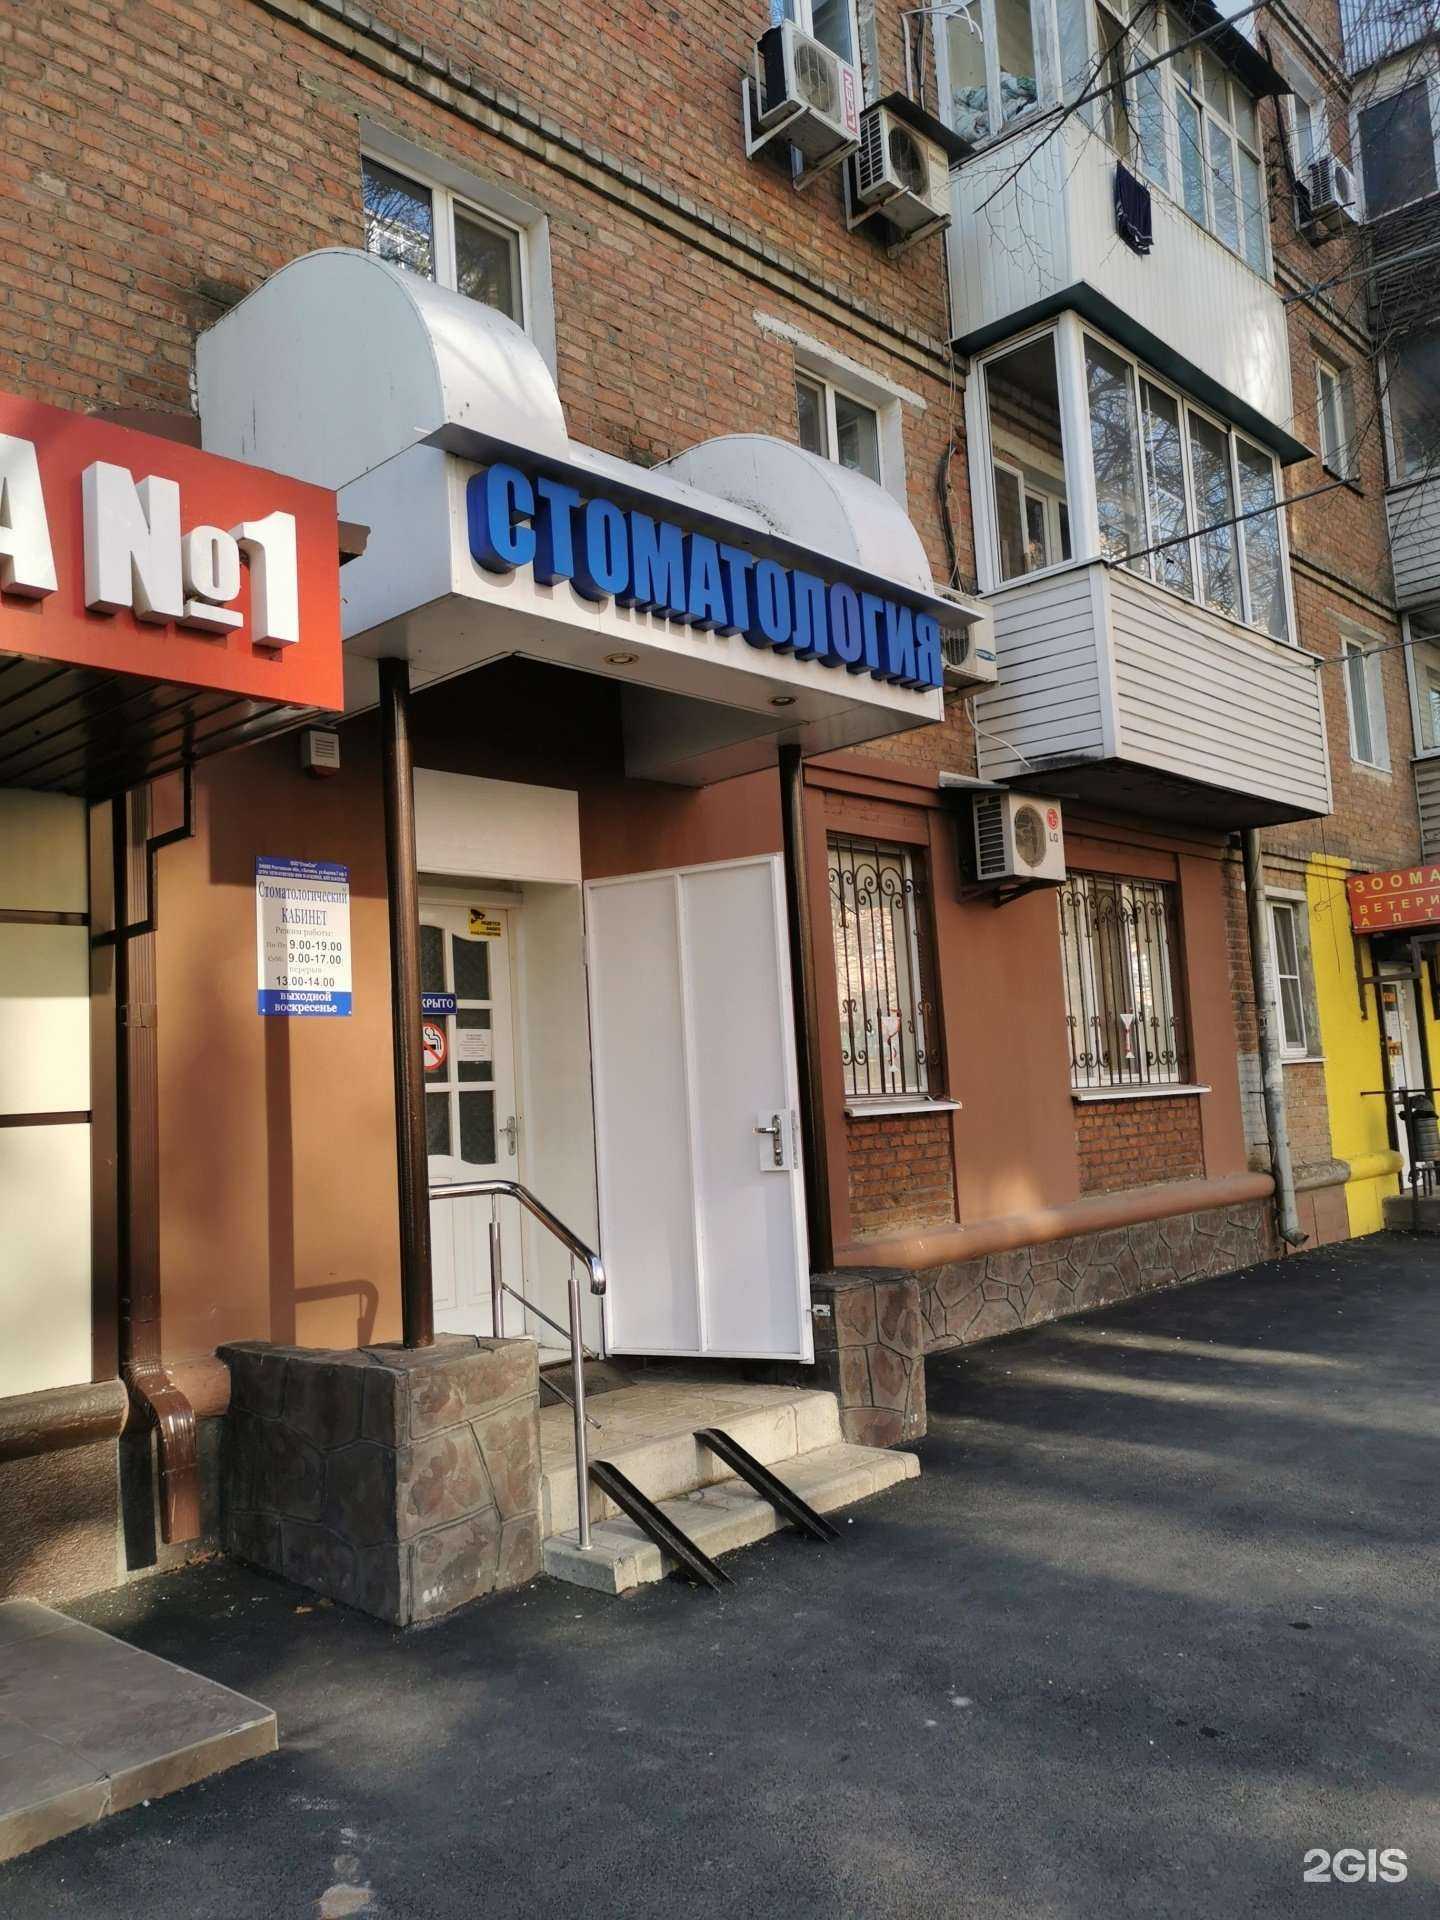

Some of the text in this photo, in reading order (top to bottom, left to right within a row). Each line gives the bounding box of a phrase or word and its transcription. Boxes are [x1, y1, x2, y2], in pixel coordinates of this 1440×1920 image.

[467, 463, 944, 692] СТОМАТОЛОГИЯ
[259, 881, 348, 904] Стоматологический
[281, 907, 327, 926] КАБИНЕТ
[289, 939, 342, 951] 9.00-19.00
[288, 952, 342, 965] 9.00-17.00
[275, 975, 335, 987] 13.00-14.00
[274, 1003, 338, 1014] воскресенье
[422, 998, 454, 1009] КРЫТО
